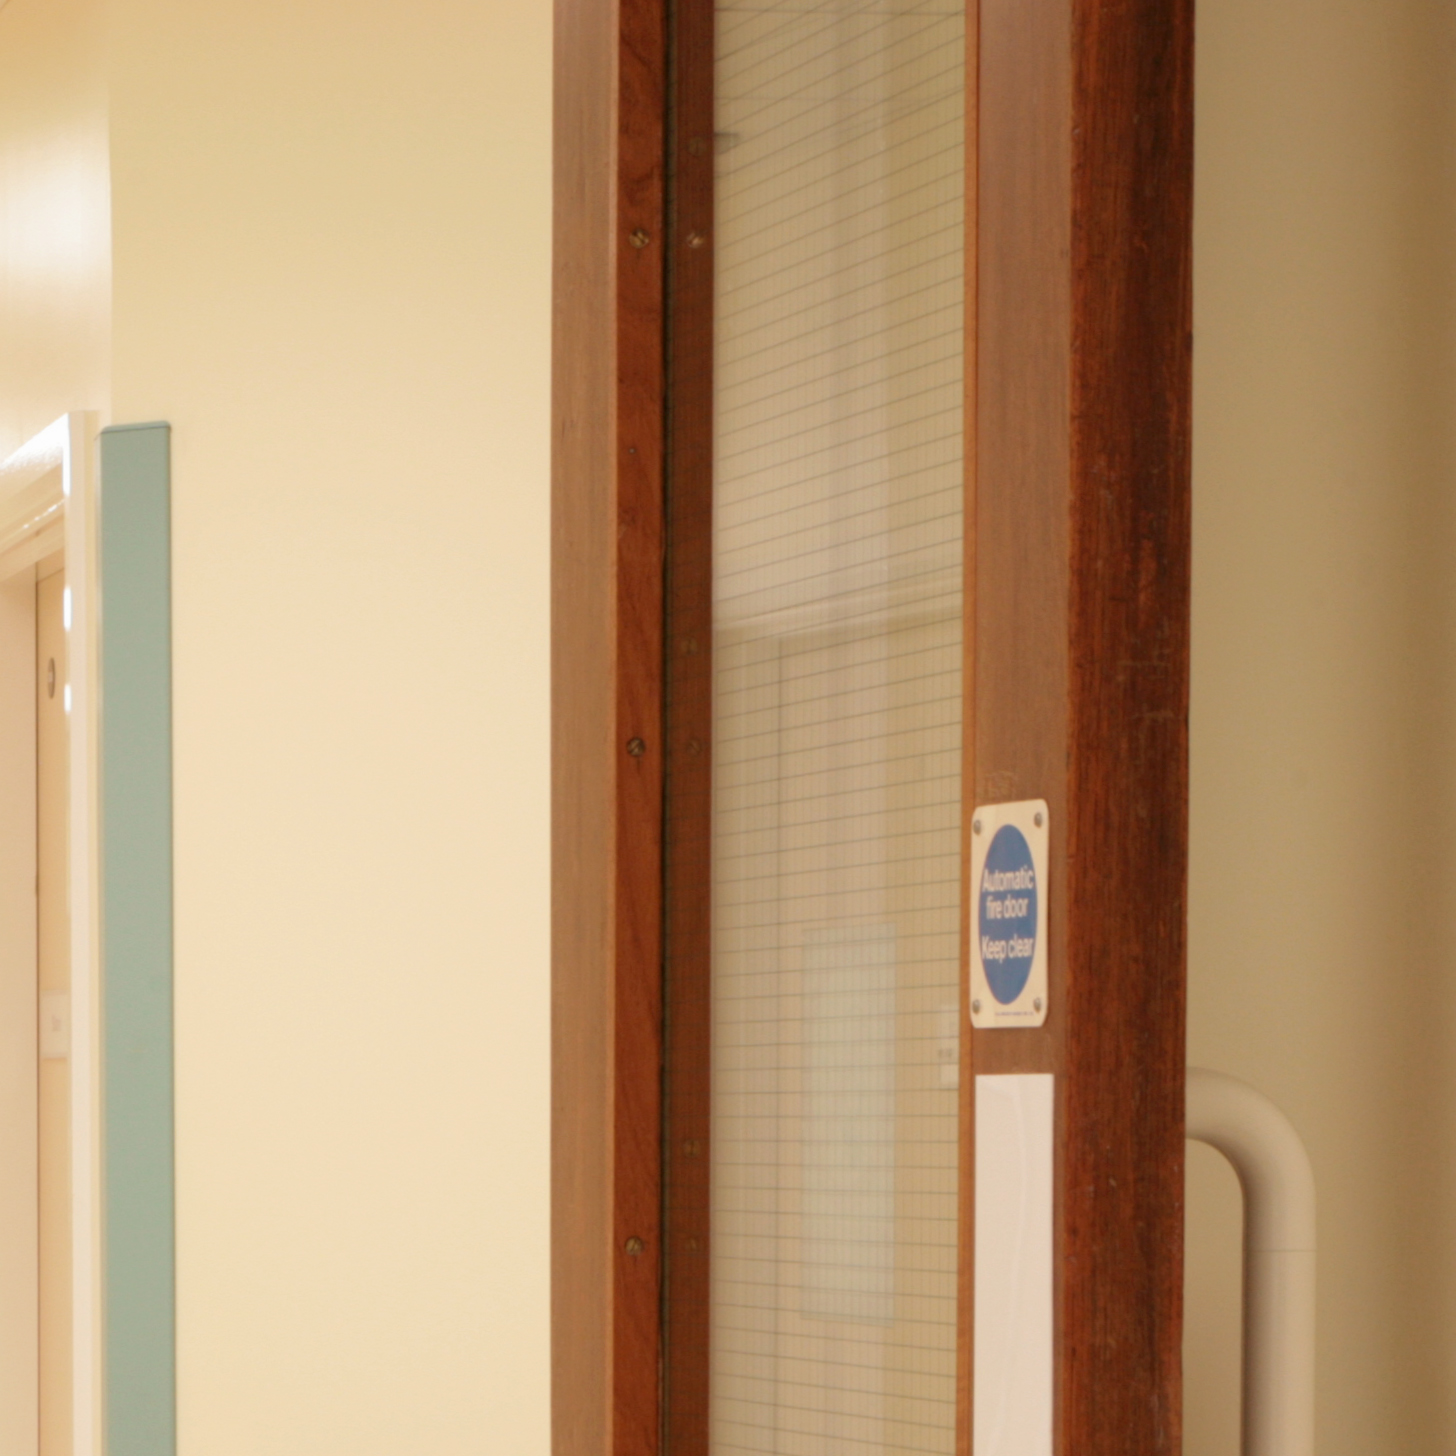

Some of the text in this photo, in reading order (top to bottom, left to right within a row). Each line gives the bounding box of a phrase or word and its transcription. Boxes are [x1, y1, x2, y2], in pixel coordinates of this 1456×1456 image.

[982, 865, 1034, 892] Automatic
[986, 893, 1029, 919] fire door
[981, 933, 1034, 963] Keep clear
